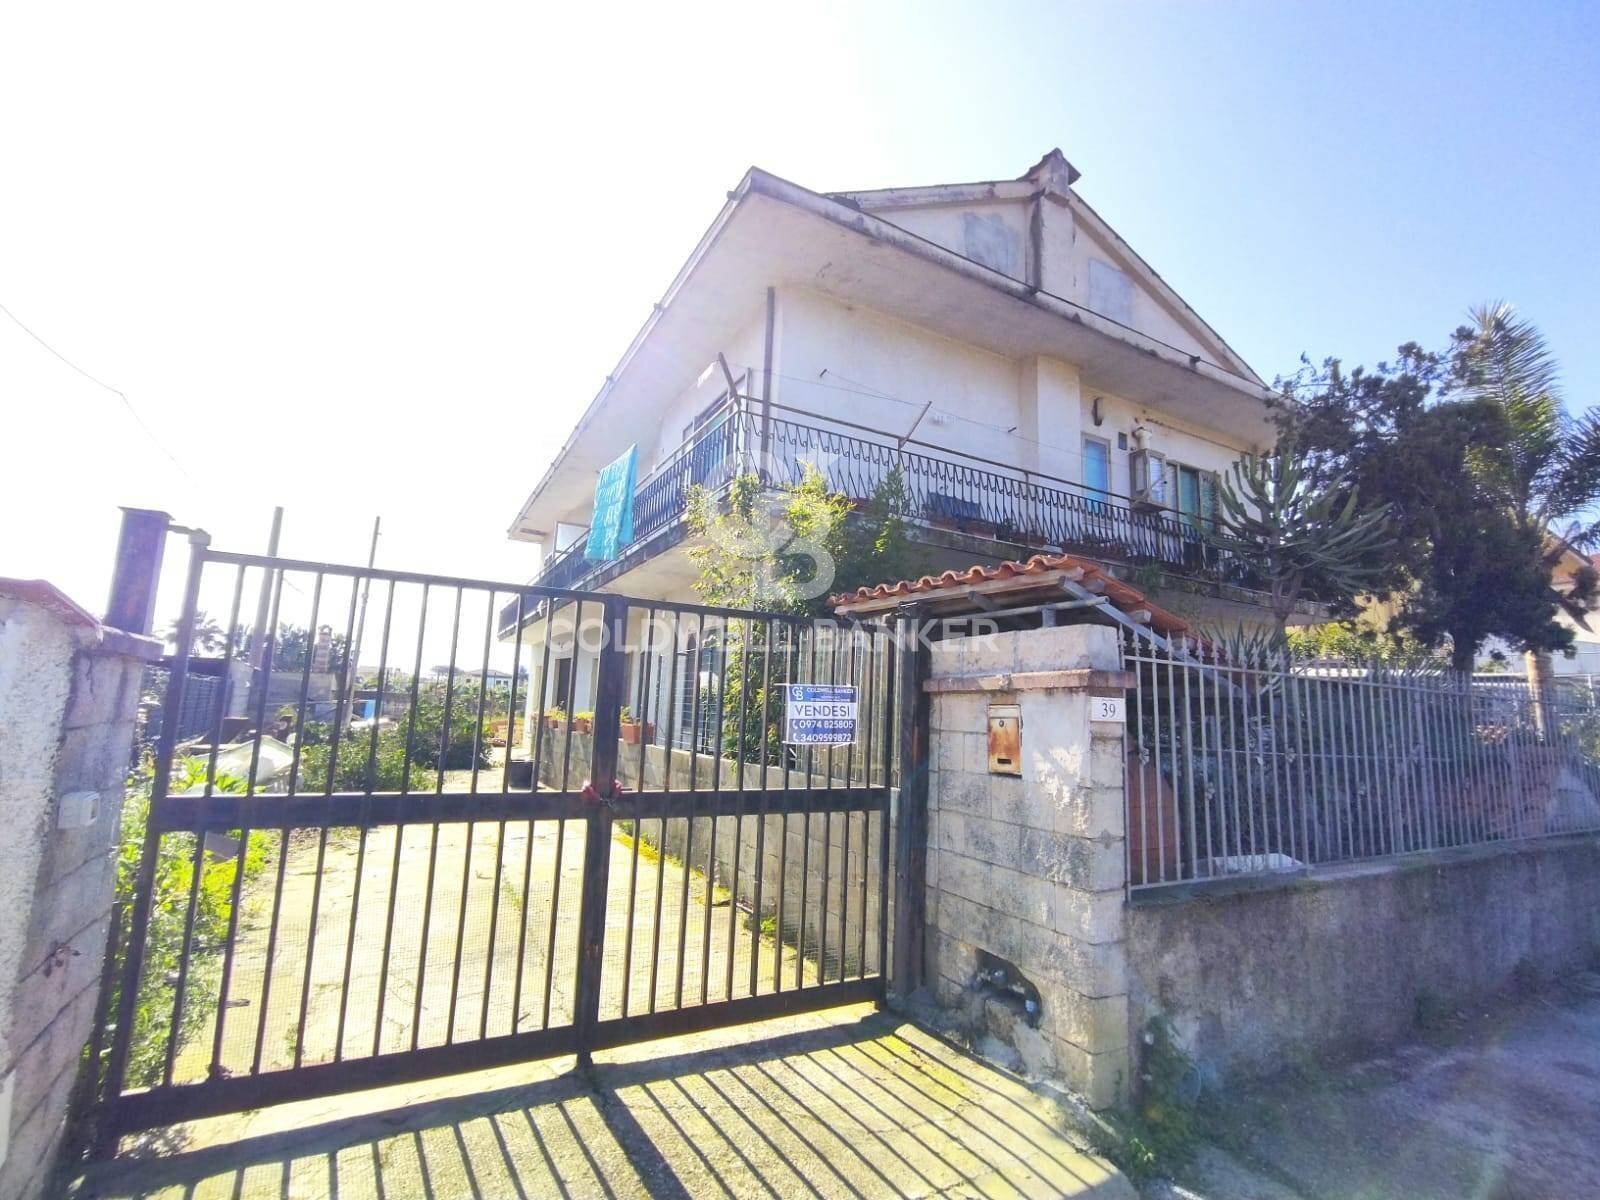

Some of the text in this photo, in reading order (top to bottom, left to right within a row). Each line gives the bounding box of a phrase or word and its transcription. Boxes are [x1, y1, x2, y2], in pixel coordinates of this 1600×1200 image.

[795, 705, 850, 717] VENDESI
[1102, 702, 1116, 717] 39
[800, 720, 822, 729] 0974
